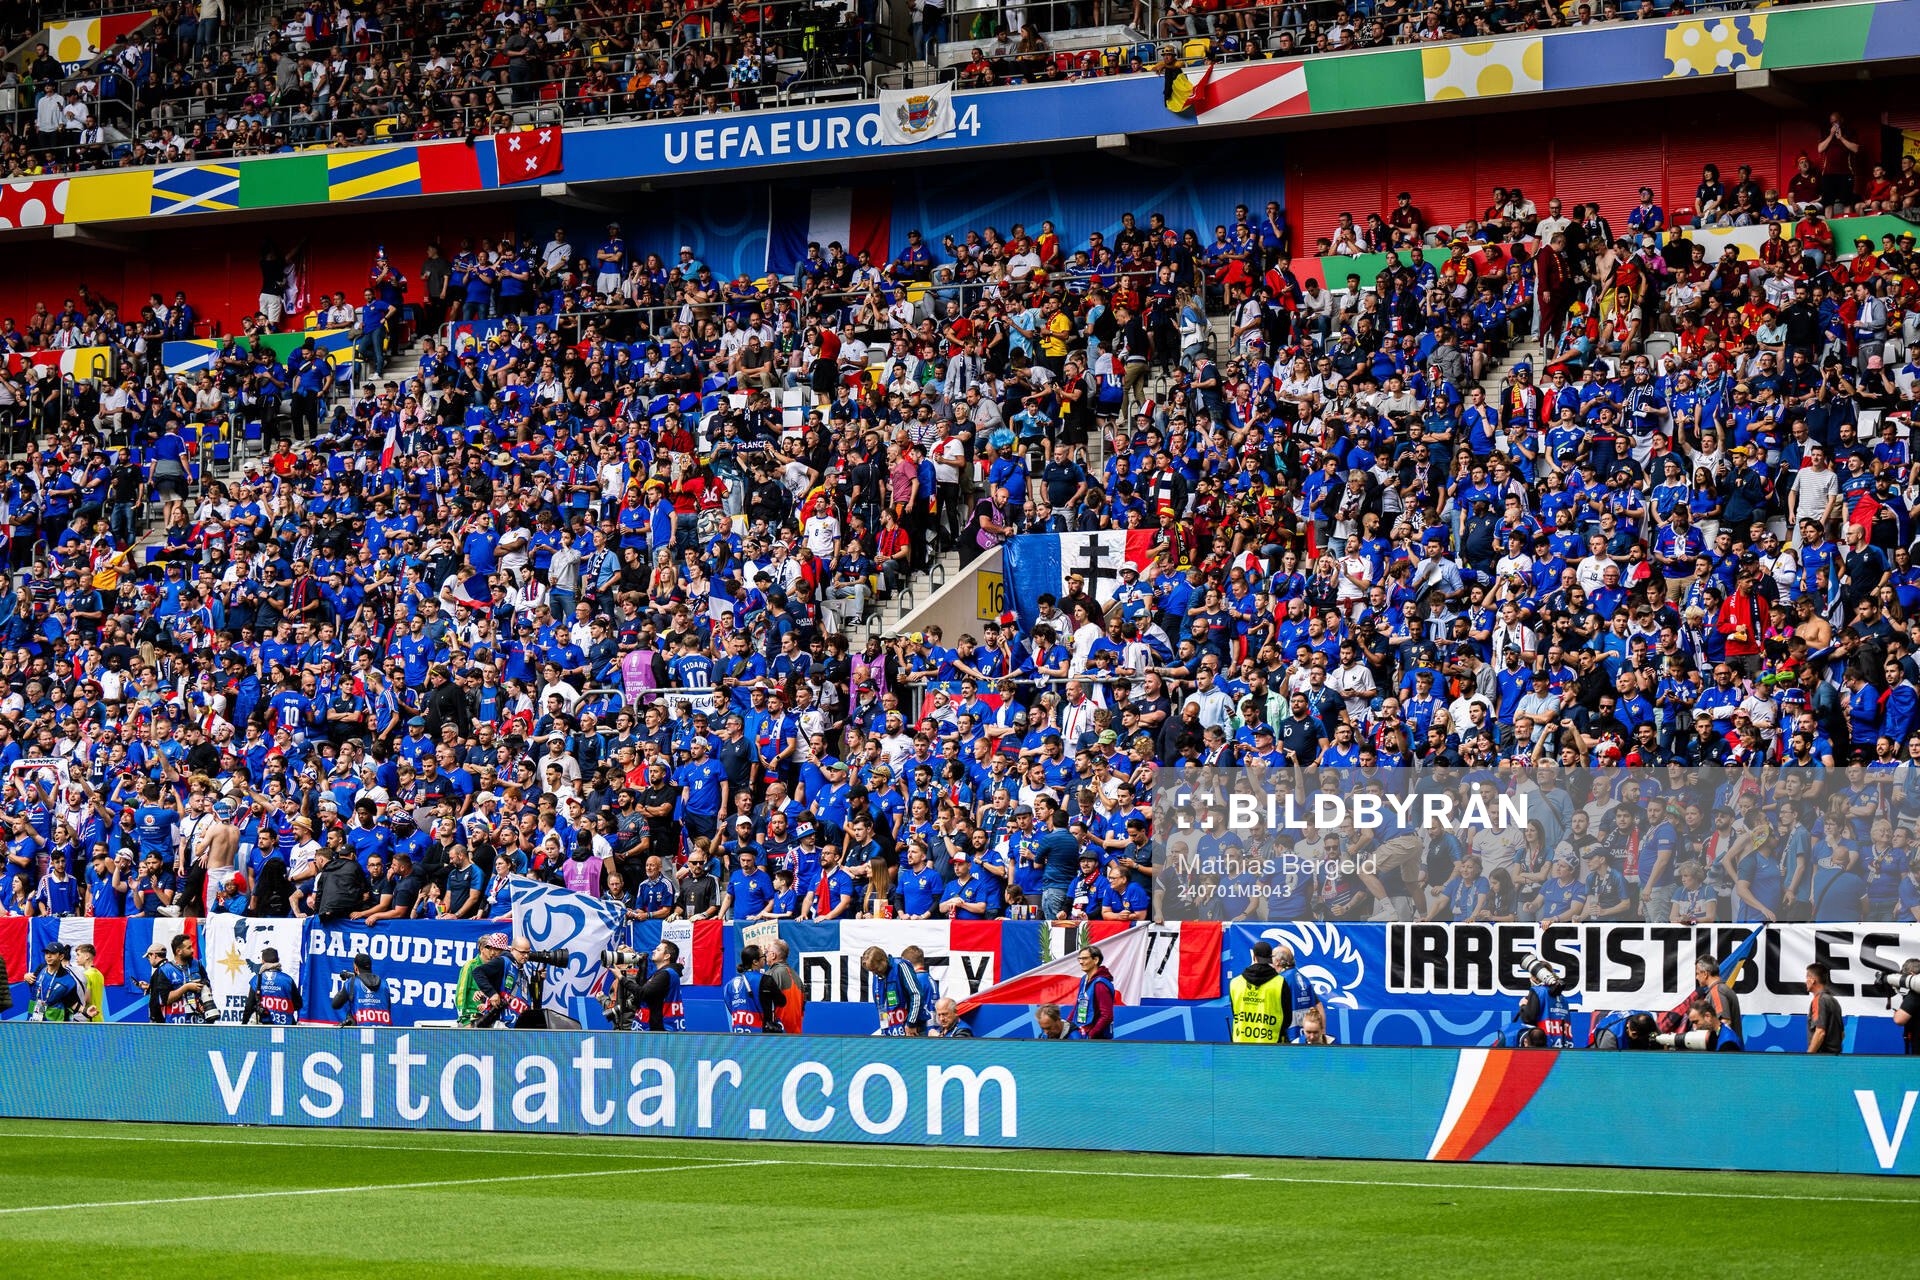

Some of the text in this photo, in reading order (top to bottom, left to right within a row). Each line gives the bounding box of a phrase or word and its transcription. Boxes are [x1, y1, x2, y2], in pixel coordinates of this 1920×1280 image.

[988, 581, 1004, 613] 16
[682, 661, 709, 672] ZIDANE
[686, 670, 708, 688] 10
[283, 705, 299, 727] 10
[309, 929, 477, 967] BAROUDEU
[1390, 924, 1901, 999] IRRESISTIBLES
[261, 997, 289, 1011] HOTO
[386, 977, 459, 1009] SPOR
[356, 1010, 390, 1023] HOTO
[209, 1028, 1018, 1138] visitqatar.com
